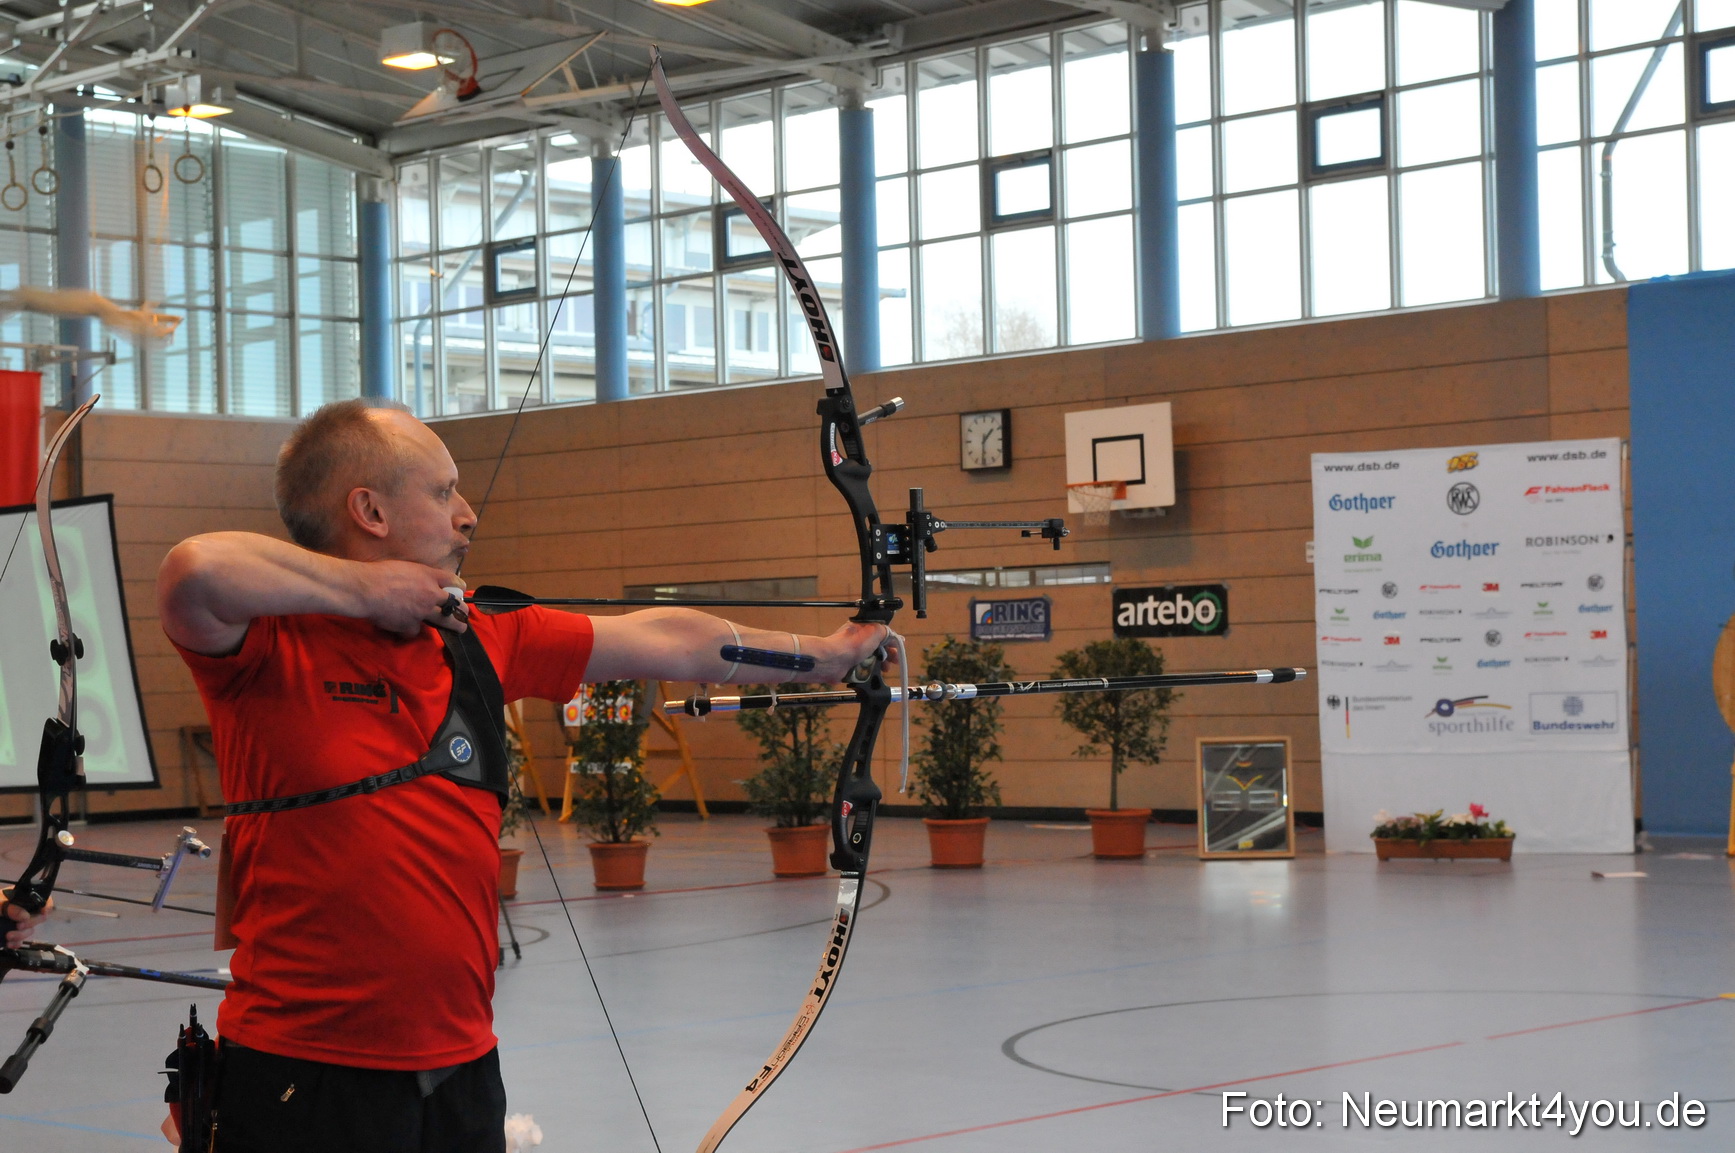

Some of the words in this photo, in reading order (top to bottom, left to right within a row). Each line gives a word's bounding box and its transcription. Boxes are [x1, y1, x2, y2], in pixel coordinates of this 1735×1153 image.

[778, 252, 830, 343] HOYT
[1527, 450, 1607, 462] www.dsb.de
[1324, 460, 1400, 472] www.dsb.de
[1329, 493, 1396, 514] Gothaer
[1430, 540, 1500, 560] Gothaer
[1525, 534, 1599, 548] ROBINSON
[1482, 582, 1499, 592] 3M
[993, 600, 1046, 624] RING
[1117, 593, 1217, 627] artebo
[1383, 636, 1400, 646] 3M
[1590, 630, 1607, 640] 3M
[1428, 717, 1515, 736] sporthilfe
[1532, 720, 1616, 731] Bundeswehr
[813, 924, 848, 1003] HOYT
[745, 1065, 772, 1092] F4
